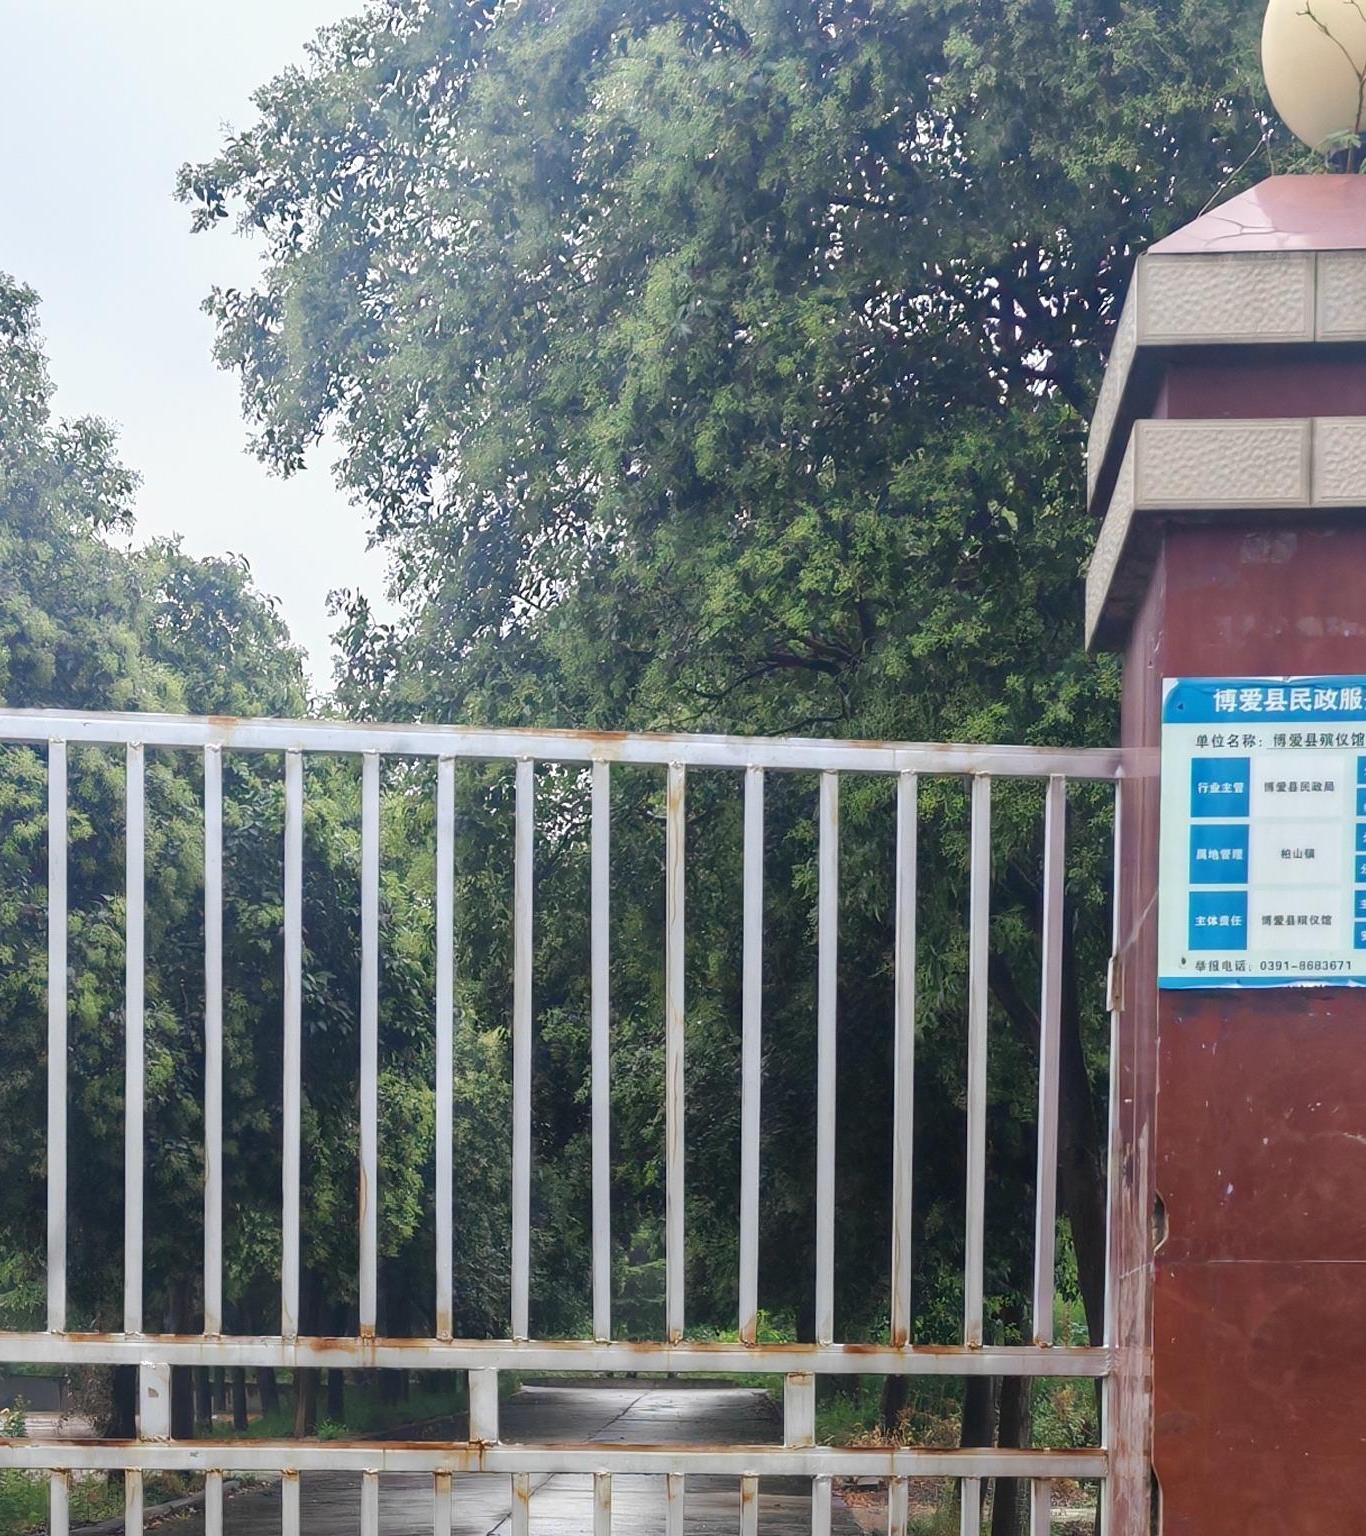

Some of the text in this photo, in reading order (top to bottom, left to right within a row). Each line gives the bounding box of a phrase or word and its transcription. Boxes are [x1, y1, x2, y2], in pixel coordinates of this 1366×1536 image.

[1272, 731, 1366, 748] 博爱县殡仪馆
[1198, 782, 1244, 794] 行业主管
[1264, 781, 1335, 793] 博爱县民政局
[1196, 848, 1243, 861] 属地管理
[1195, 915, 1243, 927] 主体责任
[1261, 915, 1332, 927] 博爱县殡仪馆
